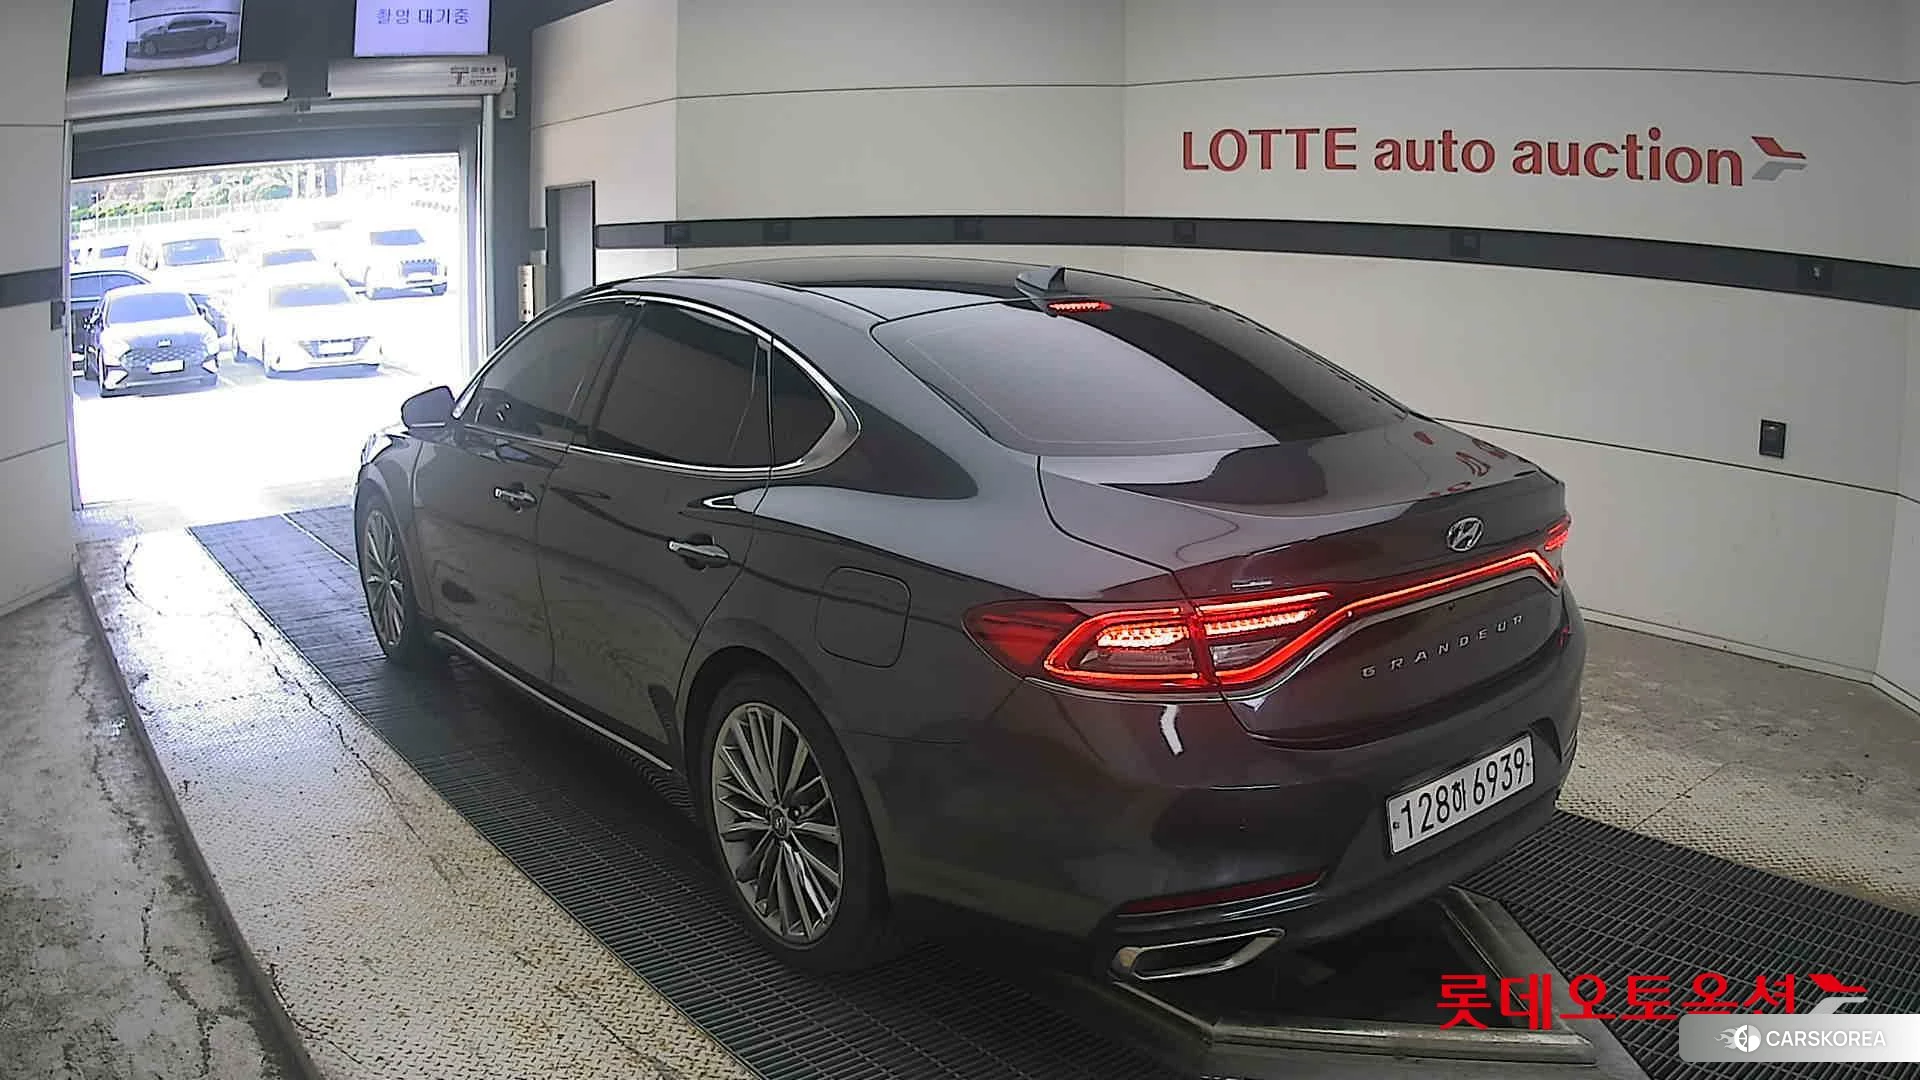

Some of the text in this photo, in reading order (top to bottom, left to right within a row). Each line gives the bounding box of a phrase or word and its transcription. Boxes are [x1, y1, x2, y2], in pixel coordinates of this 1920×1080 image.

[1182, 127, 1744, 187] LOTTE auto auction
[1361, 615, 1523, 678] GRANDEUR
